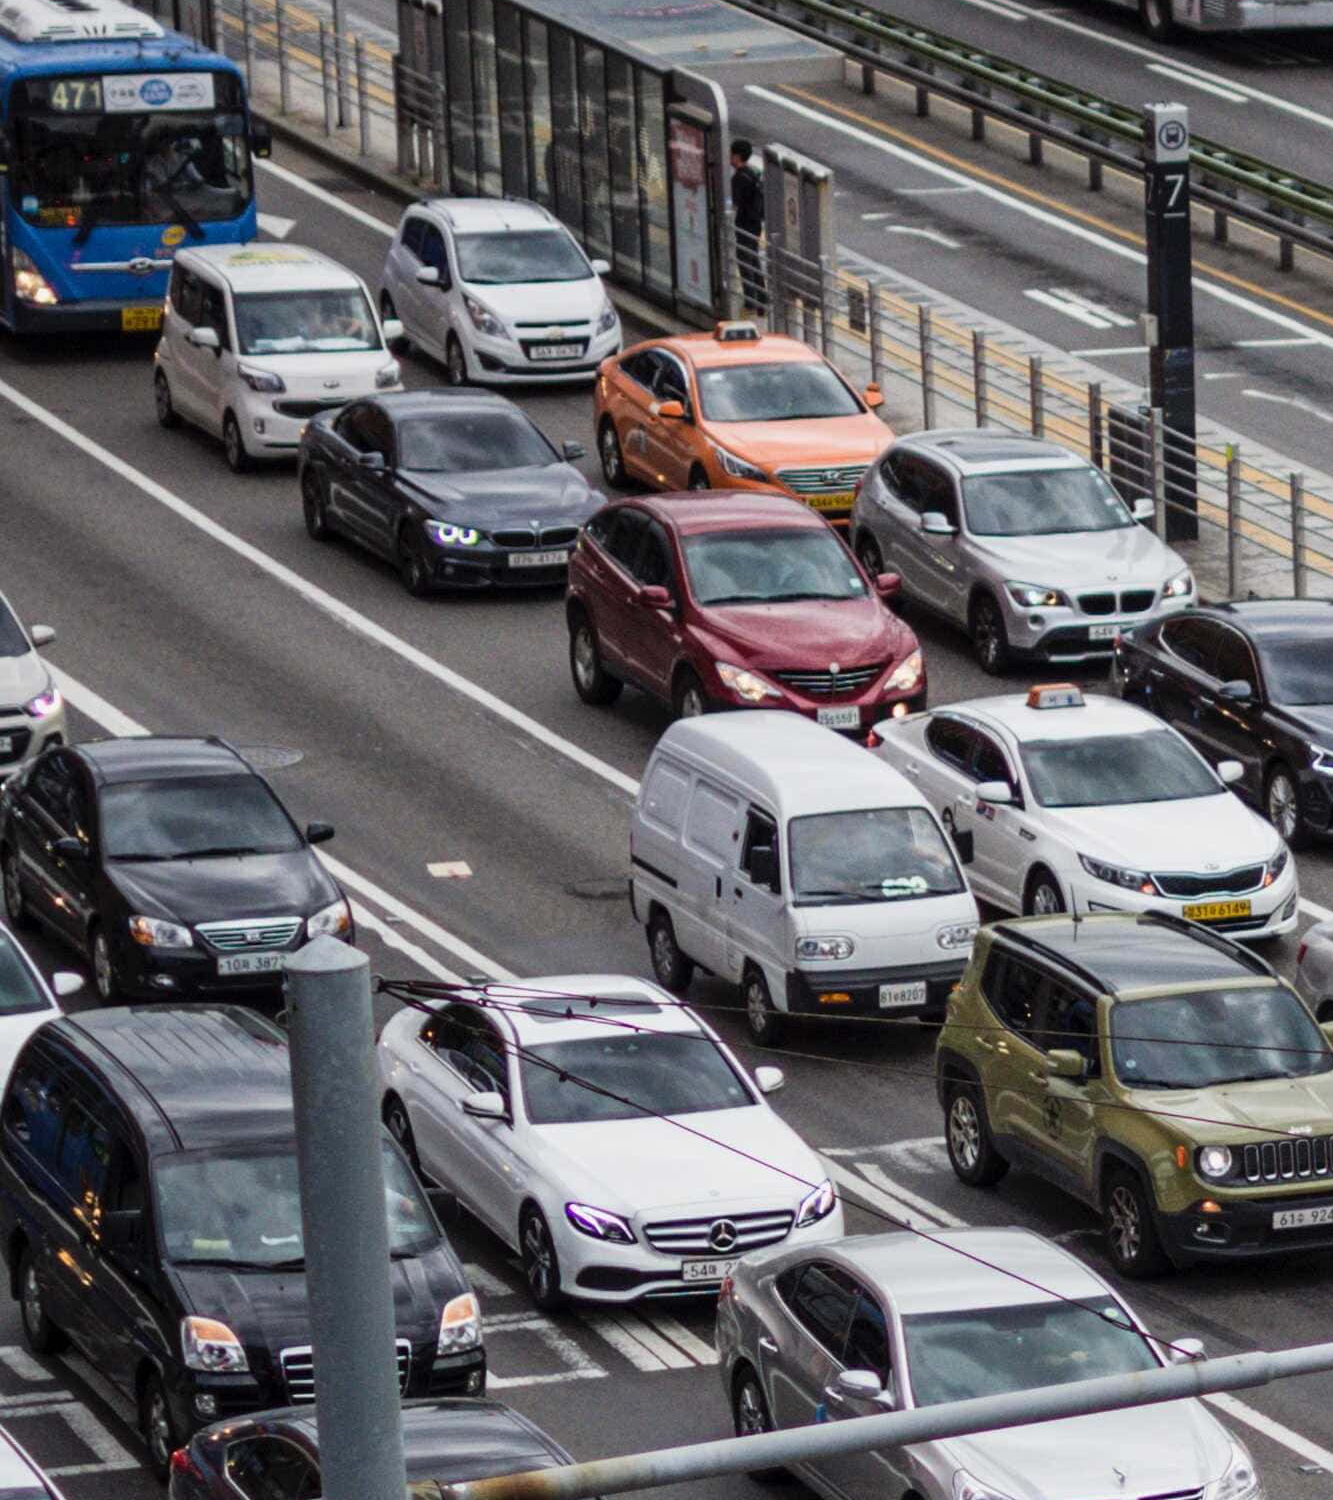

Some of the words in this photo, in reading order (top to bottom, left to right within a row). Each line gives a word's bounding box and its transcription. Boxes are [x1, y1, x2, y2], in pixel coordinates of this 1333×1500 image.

[52, 80, 102, 111] 471
[1163, 174, 1184, 208] 7
[1218, 901, 1248, 916] 6149
